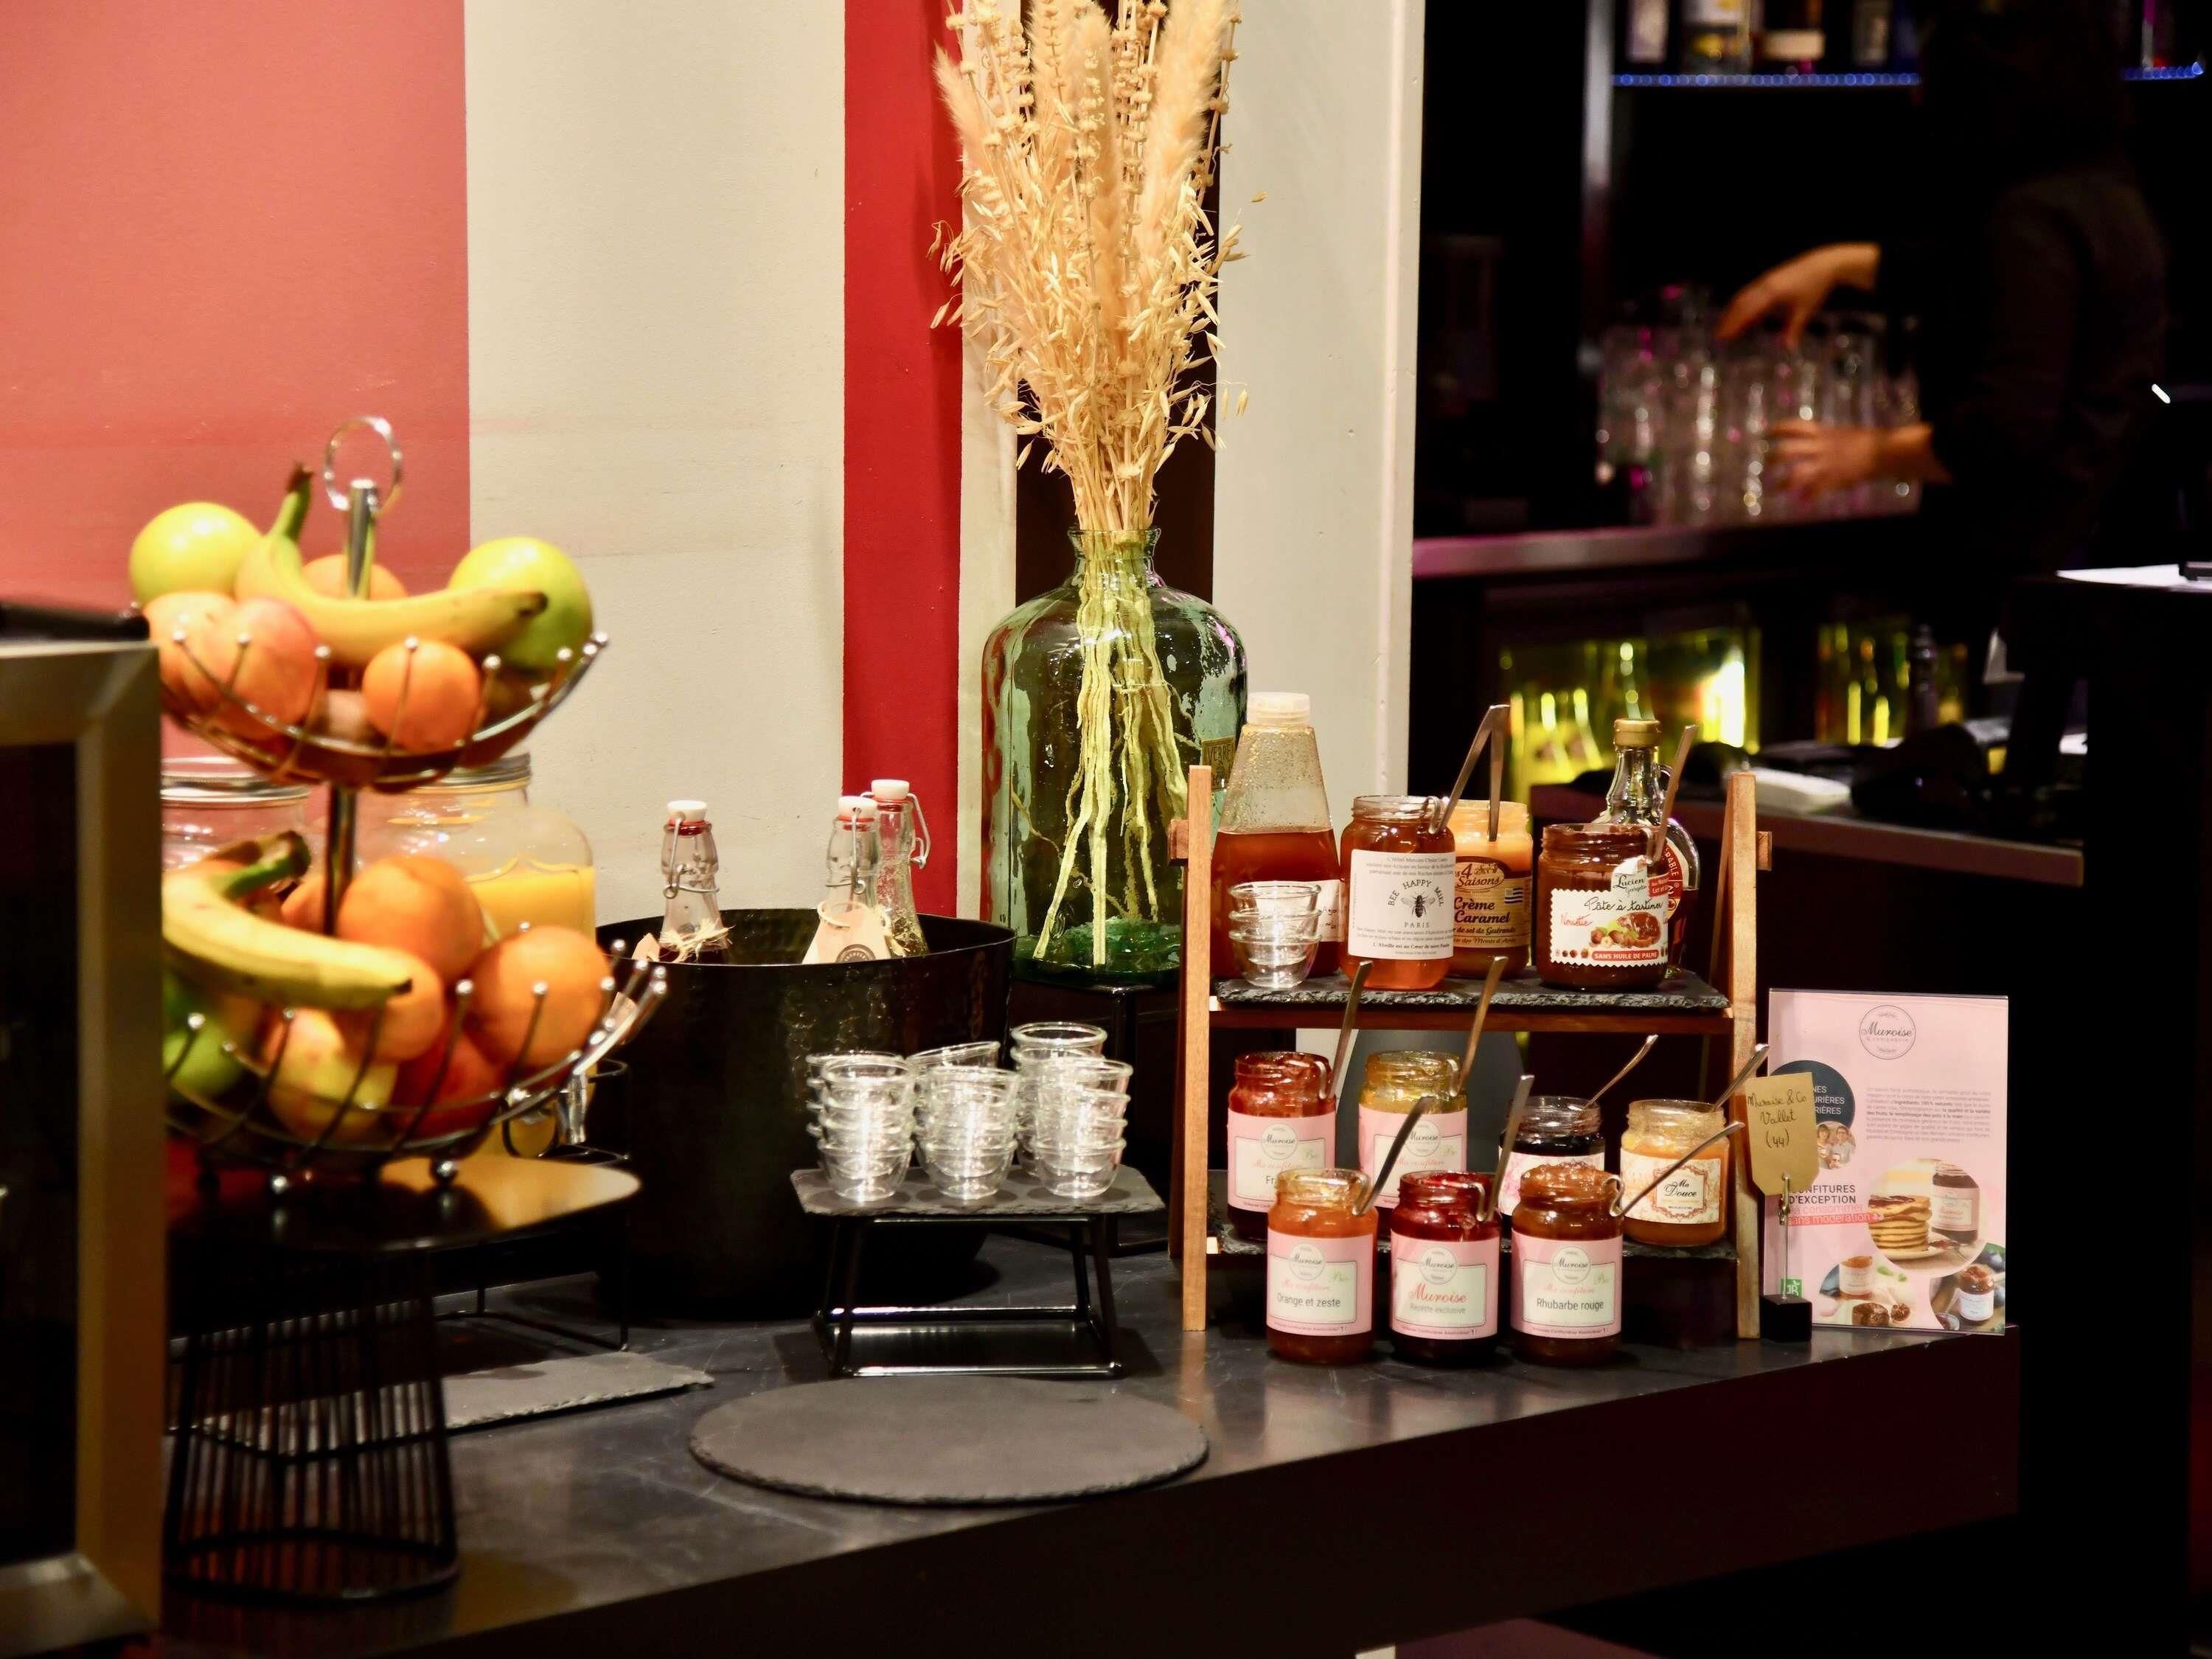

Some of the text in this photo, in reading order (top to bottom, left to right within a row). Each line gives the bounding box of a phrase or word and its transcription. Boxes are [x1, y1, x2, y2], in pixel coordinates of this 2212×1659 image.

[1461, 863, 1473, 880] 4
[1456, 875, 1500, 887] Saisons
[1613, 874, 1646, 889] Lucien
[1388, 879, 1444, 907] BEE HAPPY MIEL
[1454, 897, 1495, 910] Crème
[1585, 897, 1615, 911] Pâte
[1454, 910, 1510, 923] Caramel
[1863, 1021, 1912, 1037] Muroise
[1787, 1089, 1795, 1105] &
[1760, 1108, 1798, 1125] Vallet
[1765, 1128, 1790, 1149] (44)
[1663, 1181, 1697, 1197] Douce
[1678, 1179, 1689, 1187] Ma
[1796, 1184, 1857, 1194] NFITURES
[1790, 1195, 1857, 1204] D'EXCEPTION
[1409, 1282, 1467, 1303] Muroise
[1305, 1298, 1314, 1307] et
[1316, 1299, 1340, 1307] zeste
[1537, 1298, 1604, 1312] Rhubarbe rouge
